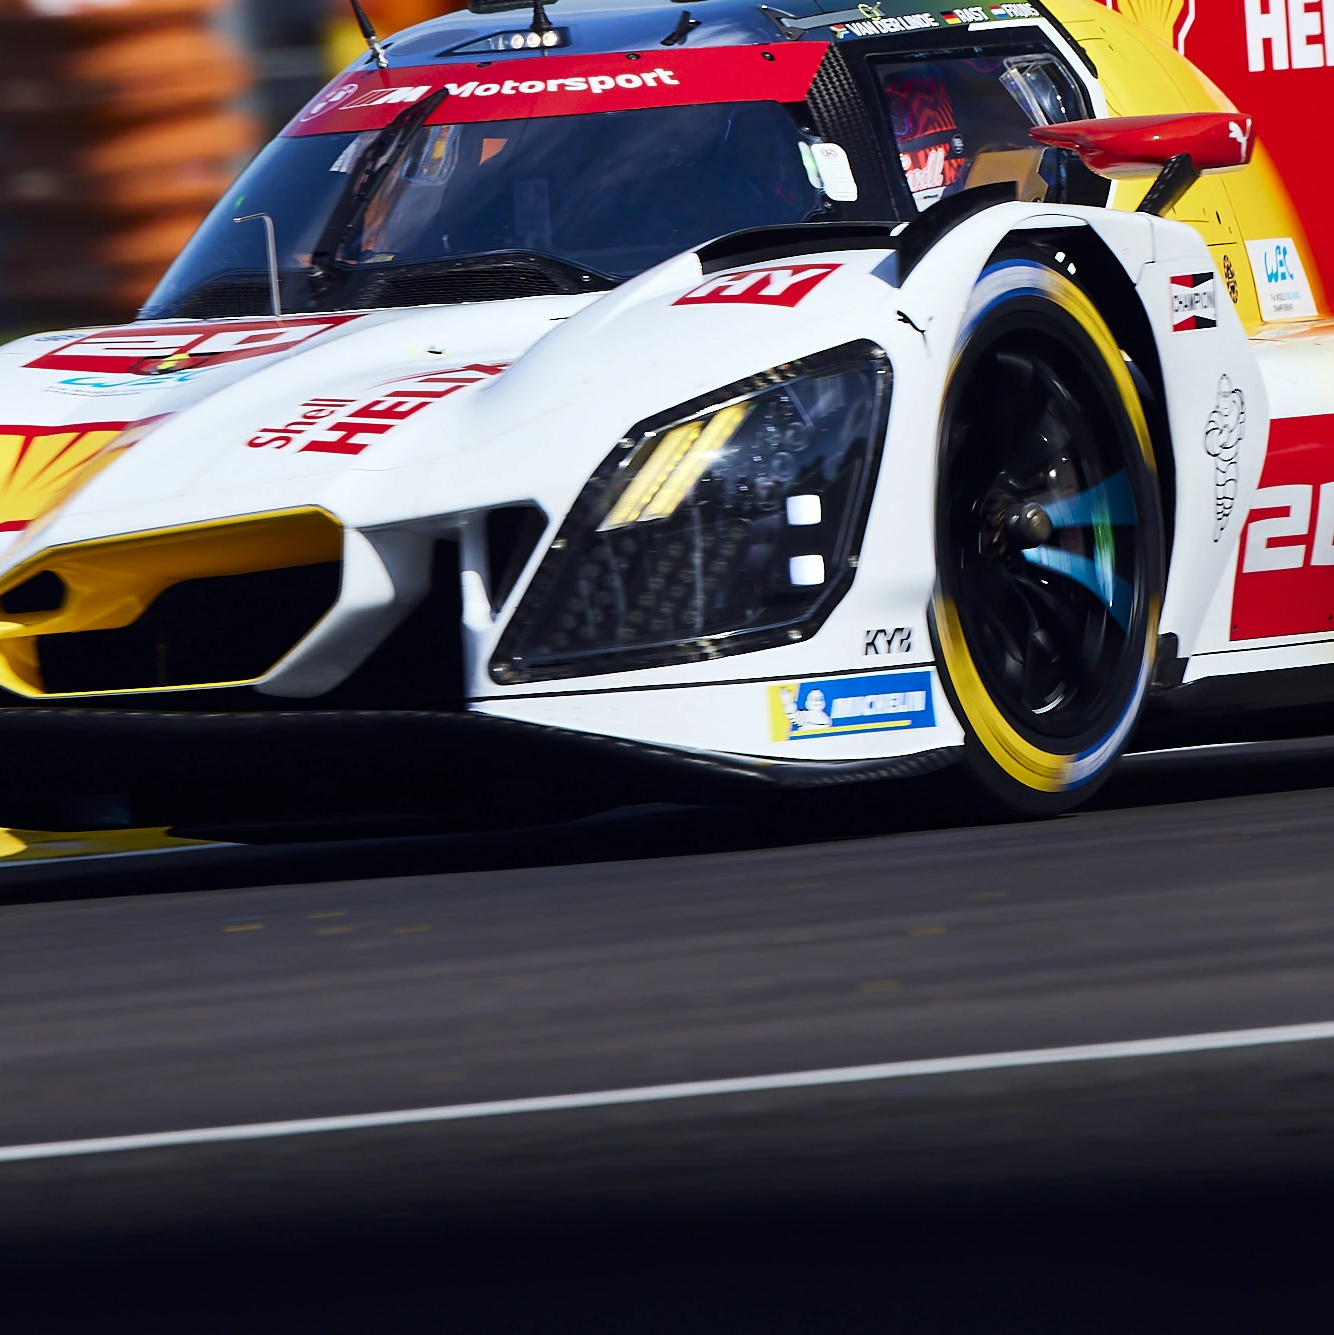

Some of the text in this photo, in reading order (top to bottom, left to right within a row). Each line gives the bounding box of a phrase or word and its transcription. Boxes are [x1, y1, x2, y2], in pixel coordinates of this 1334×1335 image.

[845, 12, 940, 37] VAN DER LINDE
[953, 6, 990, 23] RAST
[444, 67, 680, 98] Motorsport
[1264, 245, 1294, 283] WEC
[684, 267, 834, 298] HY
[52, 323, 337, 357] 20
[247, 397, 357, 450] Shell
[296, 362, 514, 455] HELIX
[864, 626, 912, 656] KYB
